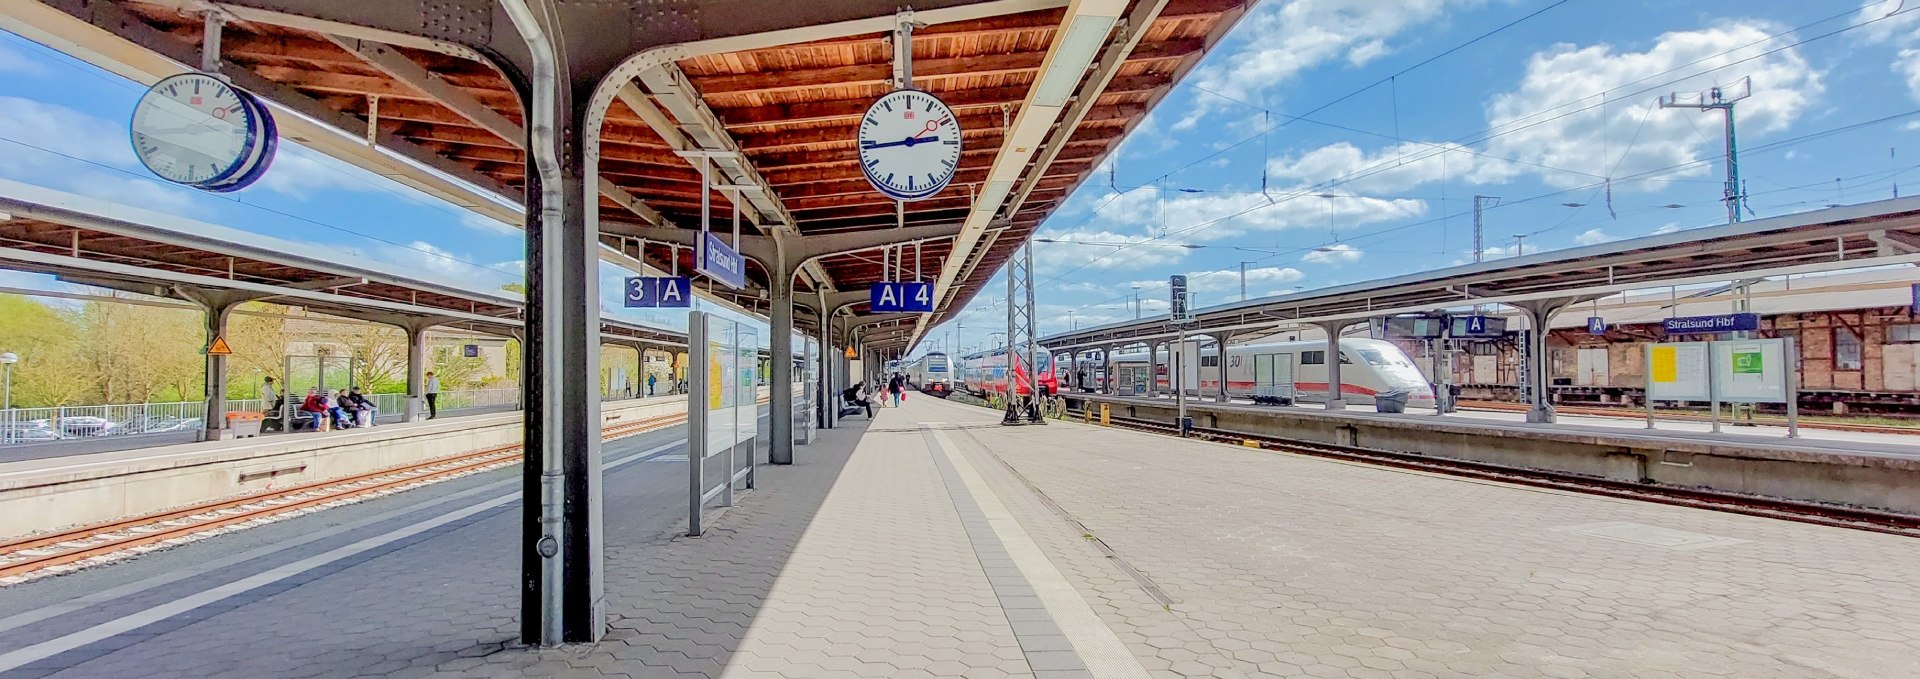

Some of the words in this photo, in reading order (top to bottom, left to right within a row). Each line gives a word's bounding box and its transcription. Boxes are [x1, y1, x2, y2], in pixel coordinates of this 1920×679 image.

[709, 241, 730, 270] Stralsund
[629, 279, 644, 301] 3
[663, 279, 681, 301] A
[879, 284, 897, 306] A
[915, 284, 929, 306] 4
[1471, 317, 1481, 331] A
[1593, 318, 1602, 331] A
[1668, 318, 1714, 329] Stralsund
[1716, 316, 1735, 327] Hbf
